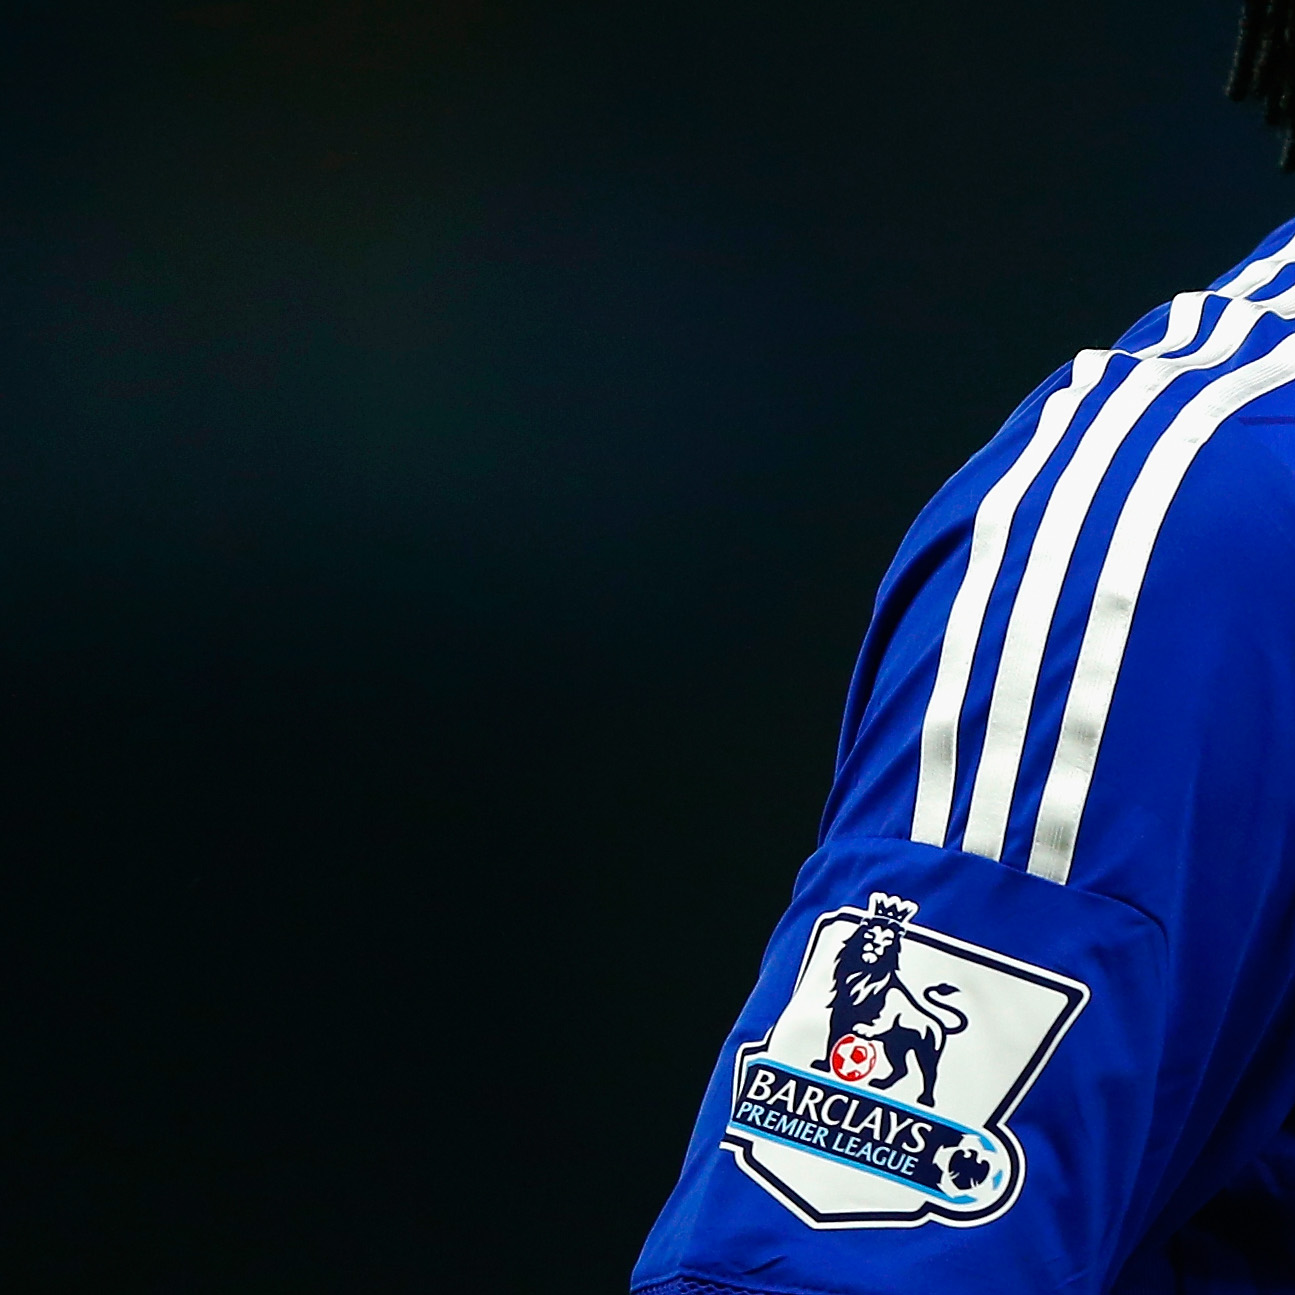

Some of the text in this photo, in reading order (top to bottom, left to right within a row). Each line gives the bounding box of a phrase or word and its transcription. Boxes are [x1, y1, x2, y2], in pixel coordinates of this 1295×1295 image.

[736, 1102, 919, 1175] PREMIER LEAGUE
[747, 1069, 932, 1153] BARCLAYS
